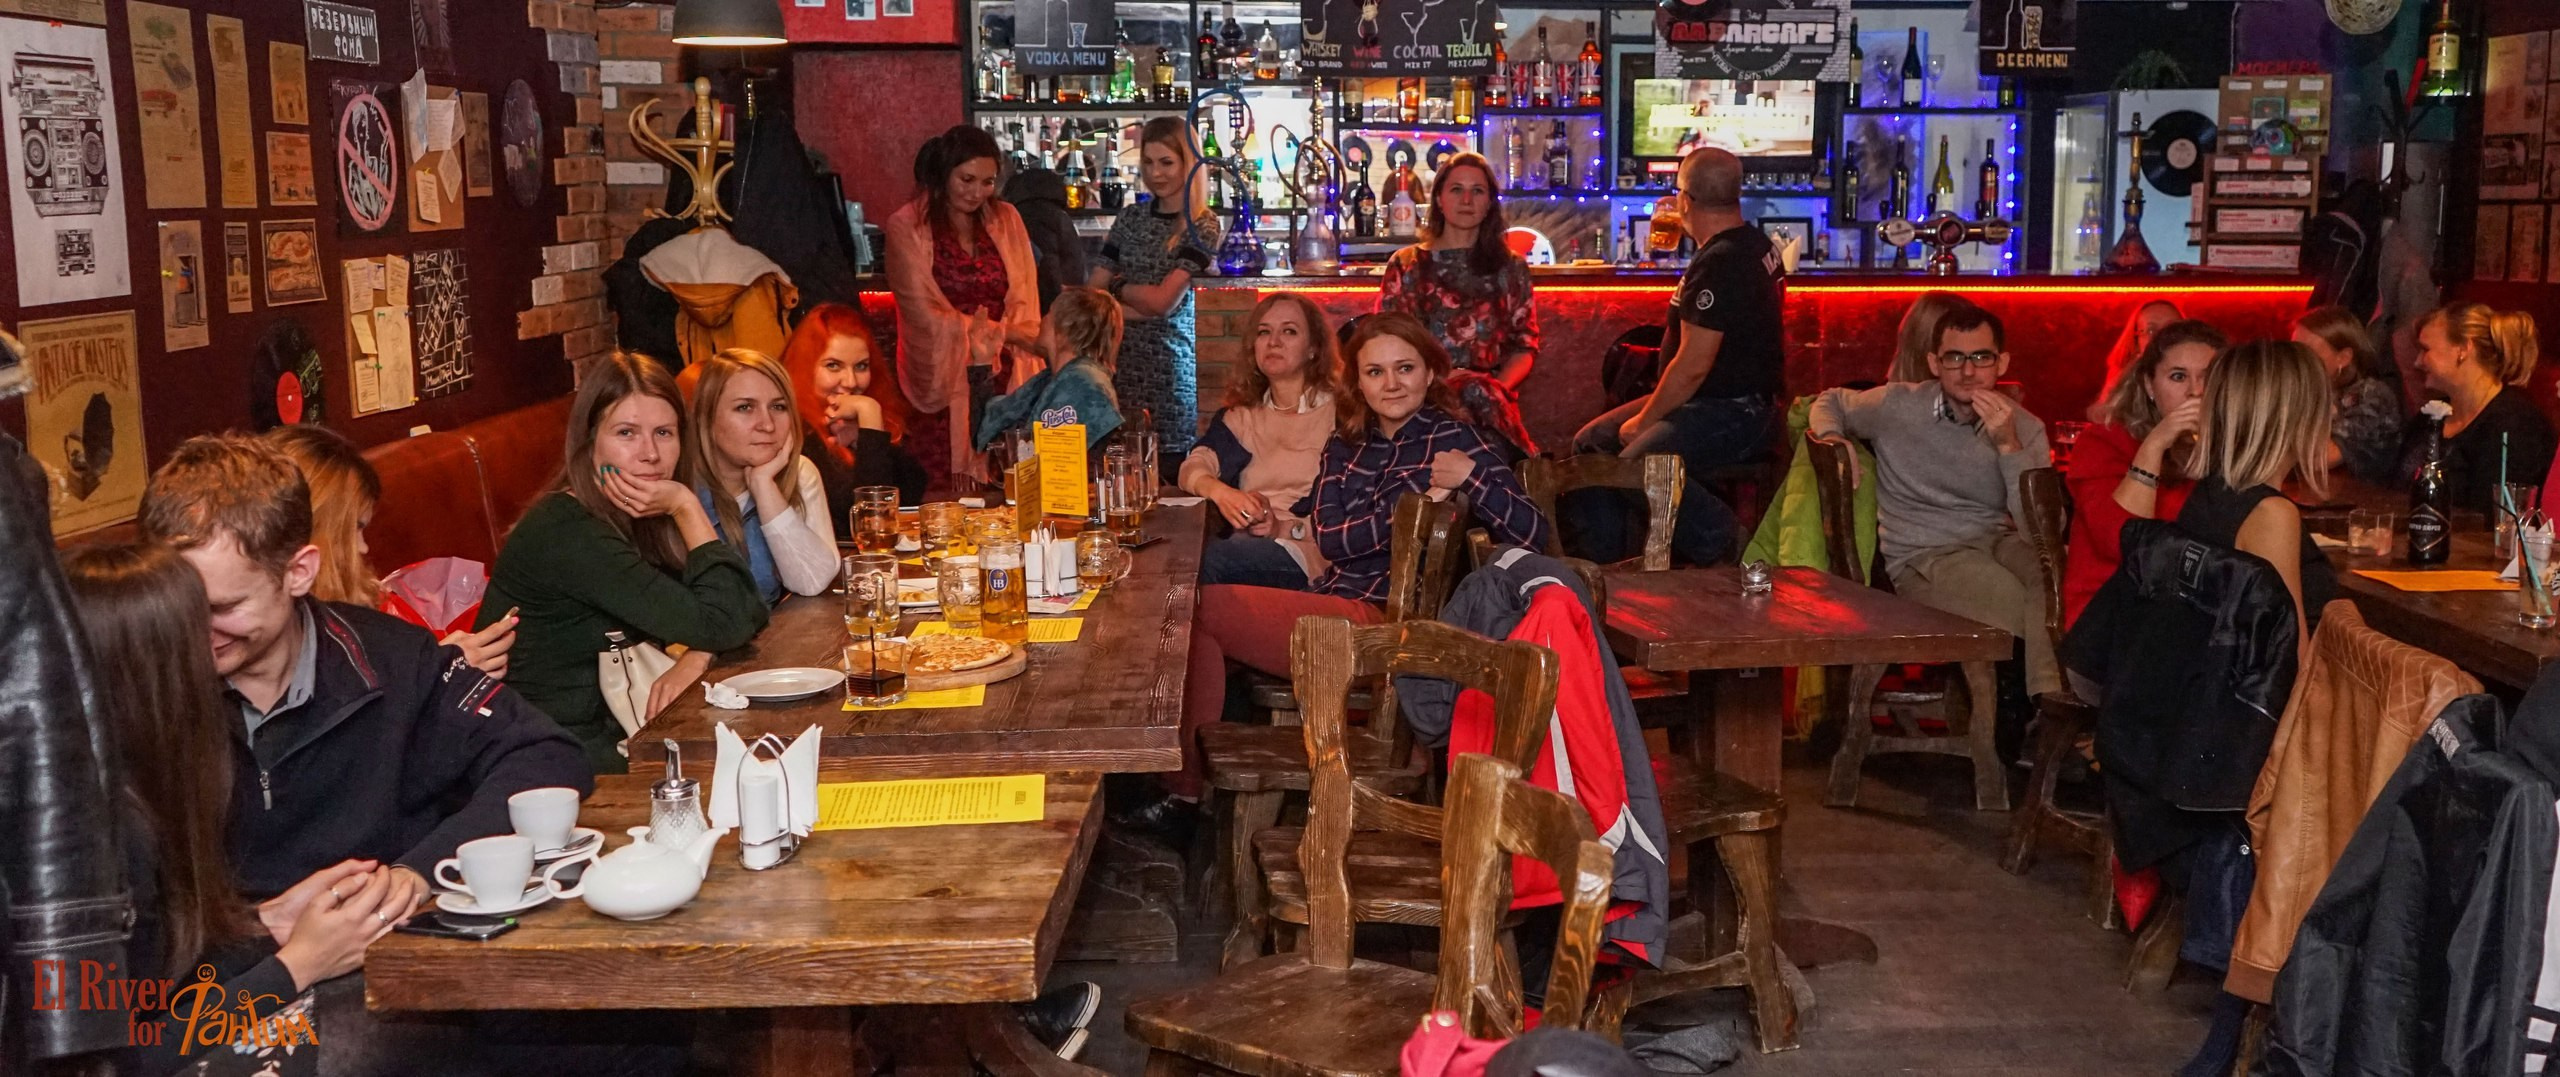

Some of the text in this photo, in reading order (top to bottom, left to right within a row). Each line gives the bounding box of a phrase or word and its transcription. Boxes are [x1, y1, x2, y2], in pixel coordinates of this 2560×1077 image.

[334, 34, 364, 60] ФОНД
[1393, 45, 1442, 58] COCTAIL
[1446, 43, 1492, 57] TEQUILA
[1025, 51, 1106, 66] VODKA MENU
[1448, 59, 1488, 68] MEXICANO
[993, 579, 1004, 588] HB
